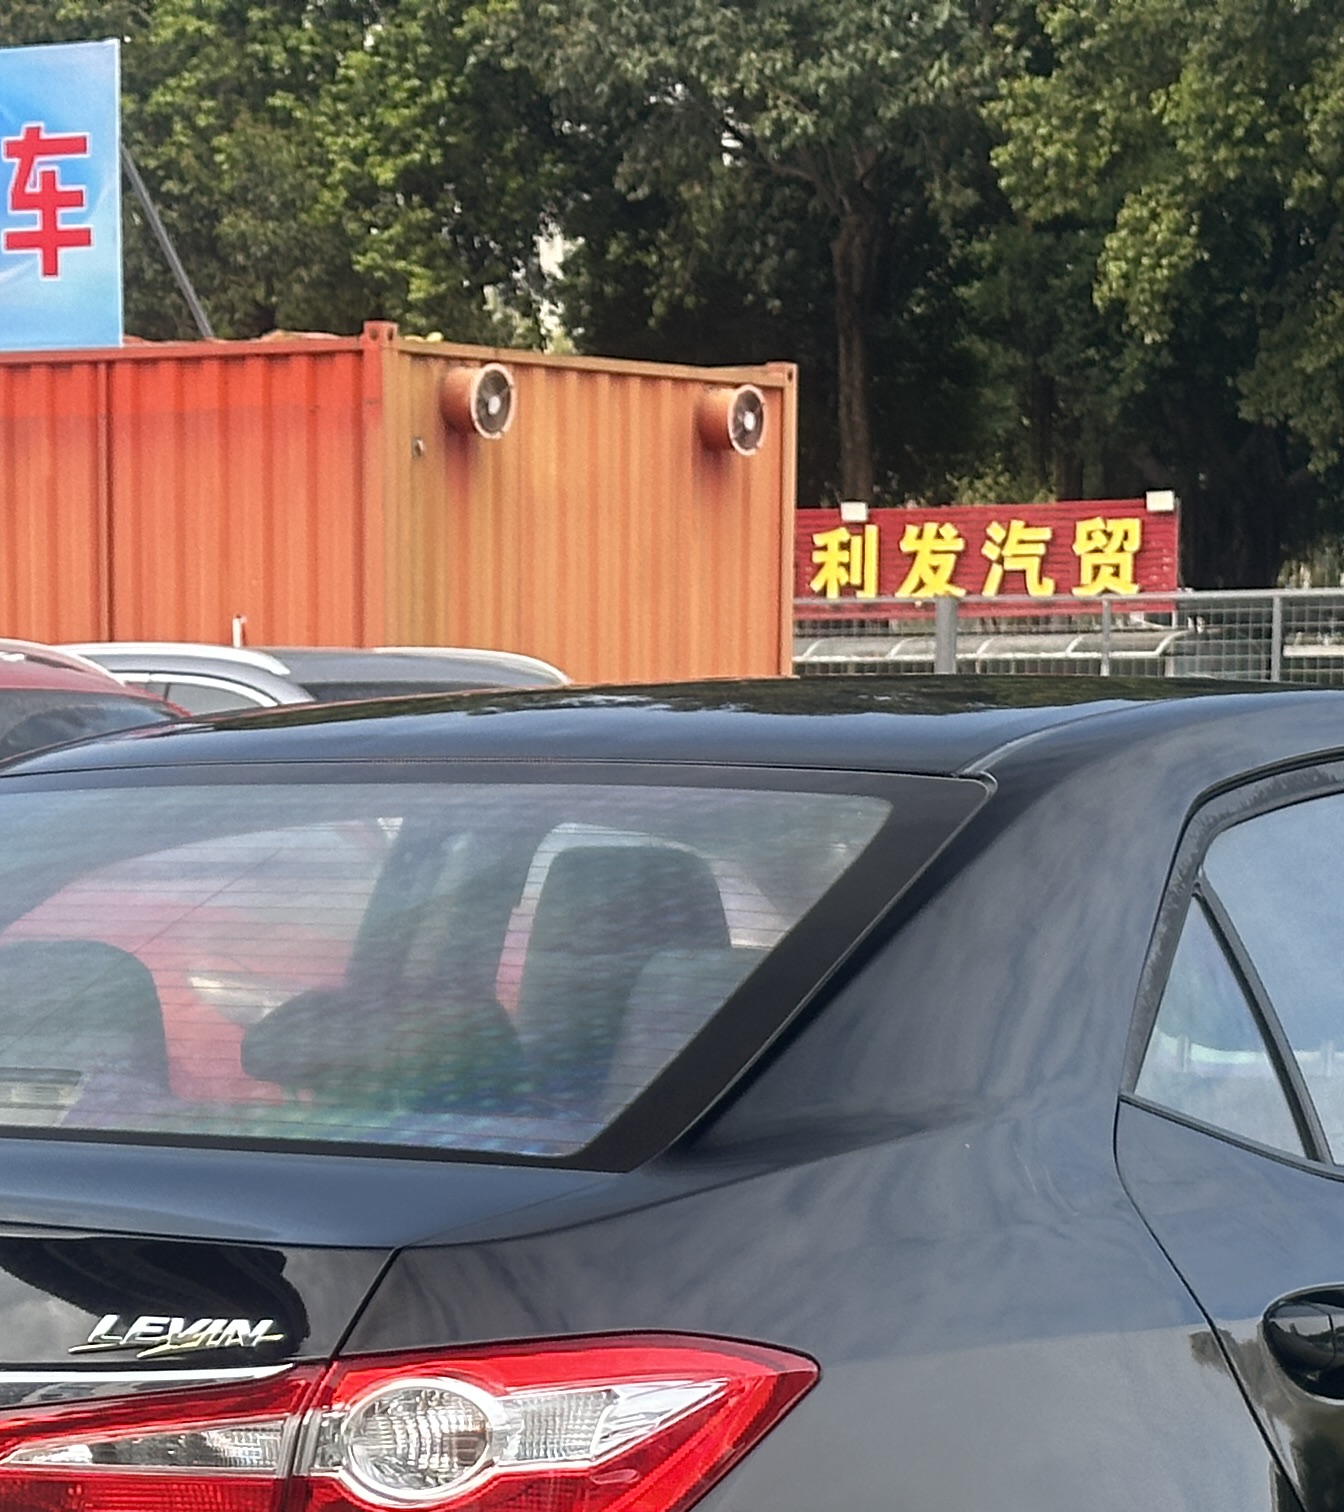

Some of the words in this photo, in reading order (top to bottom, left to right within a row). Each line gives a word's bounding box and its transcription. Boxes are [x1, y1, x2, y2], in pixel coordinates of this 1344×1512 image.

[809, 516, 1141, 599] 利发汽贸
[68, 1313, 284, 1359] LEVIN
